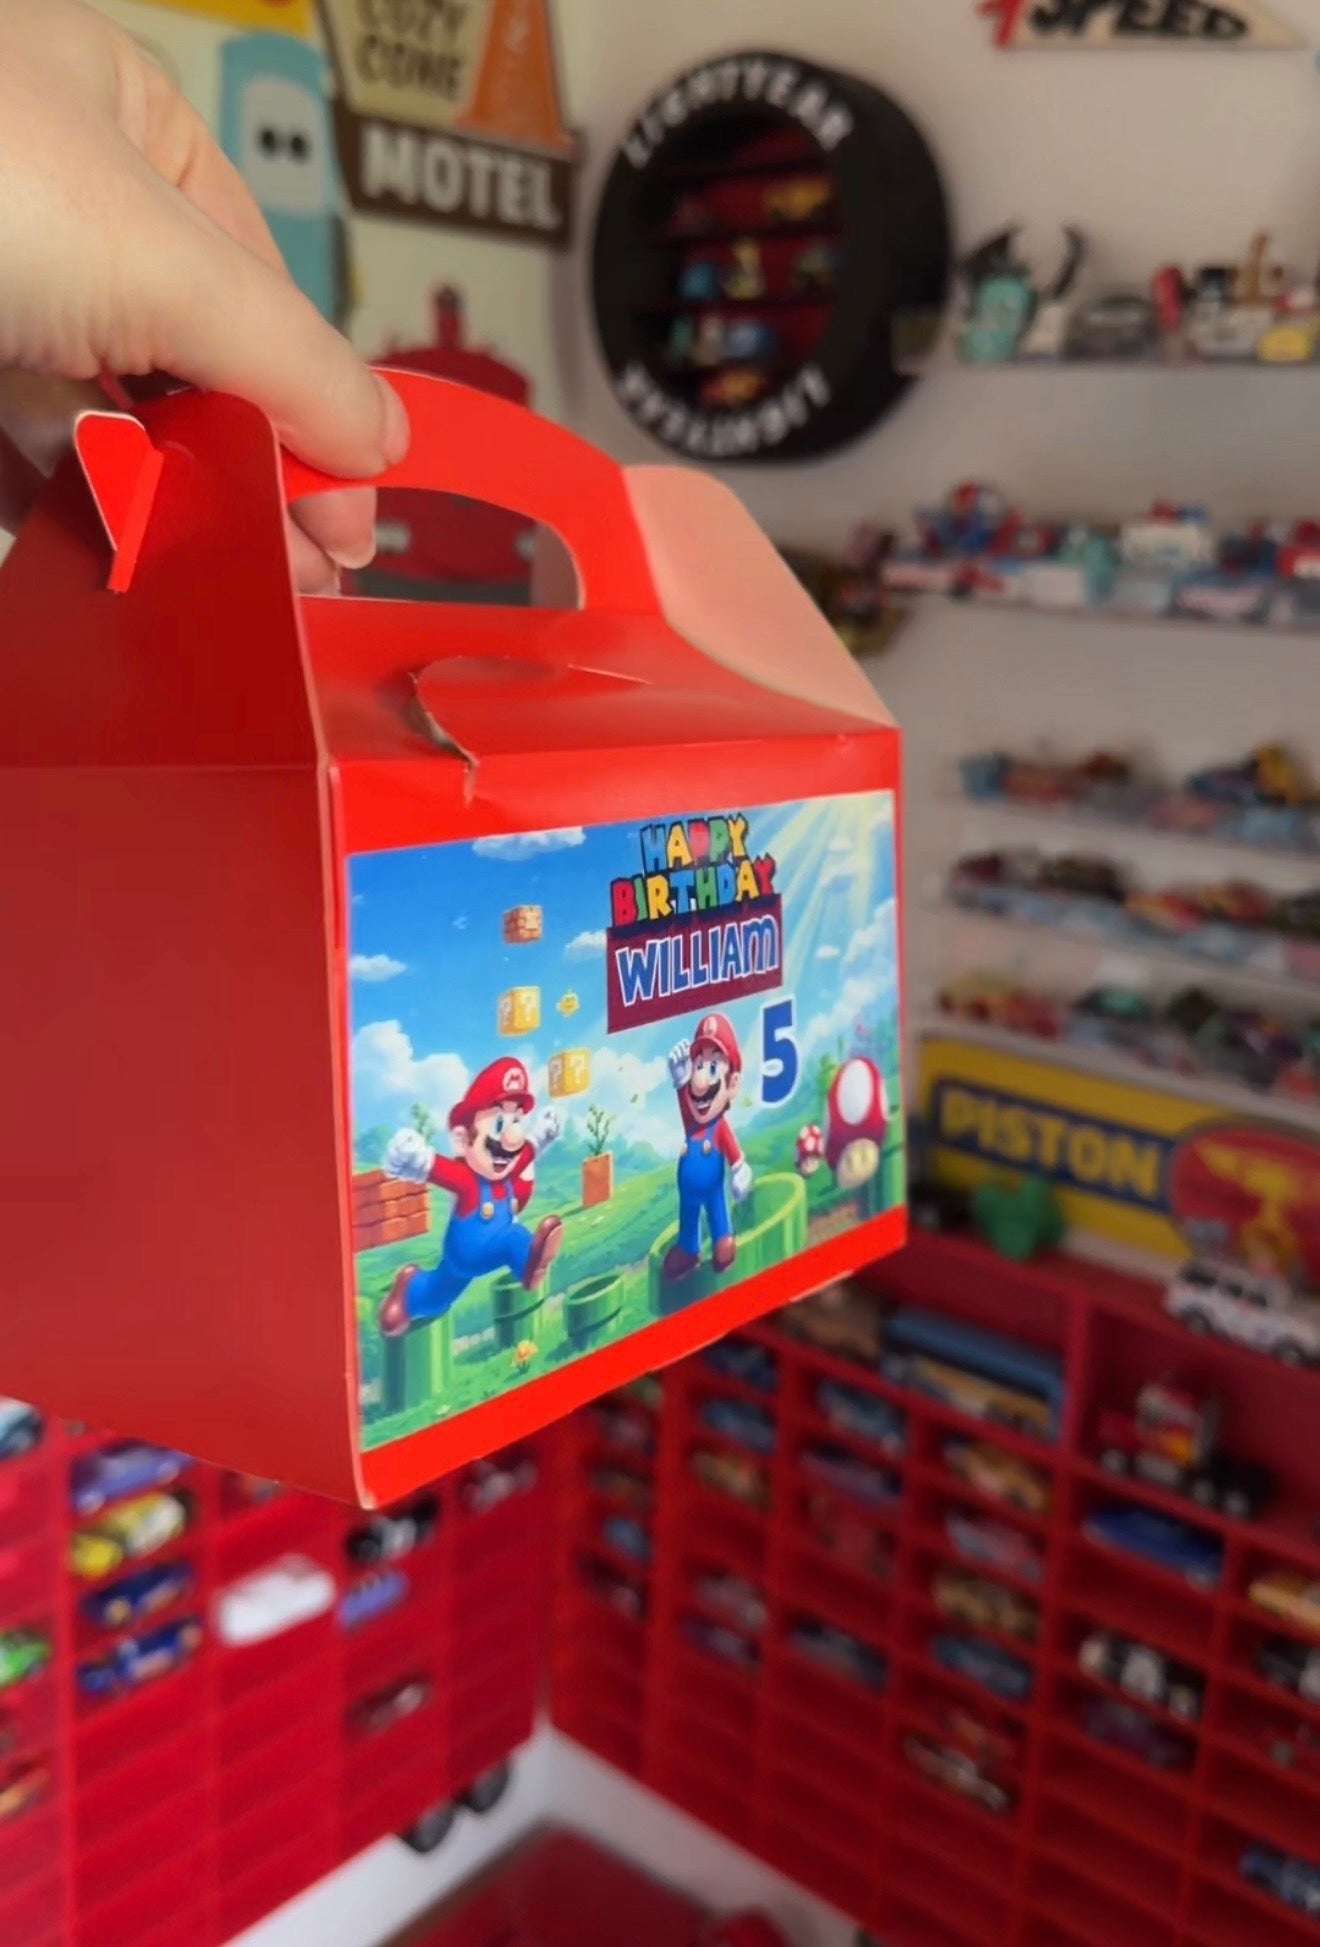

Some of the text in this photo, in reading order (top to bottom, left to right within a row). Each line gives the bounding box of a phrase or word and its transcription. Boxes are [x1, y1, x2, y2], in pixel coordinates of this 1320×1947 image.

[362, 121, 560, 231] MOTEL
[610, 852, 777, 930] BIRTHDAY
[640, 813, 749, 875] HAPPY
[757, 994, 801, 1109] 5
[938, 1087, 1163, 1201] PISTON
